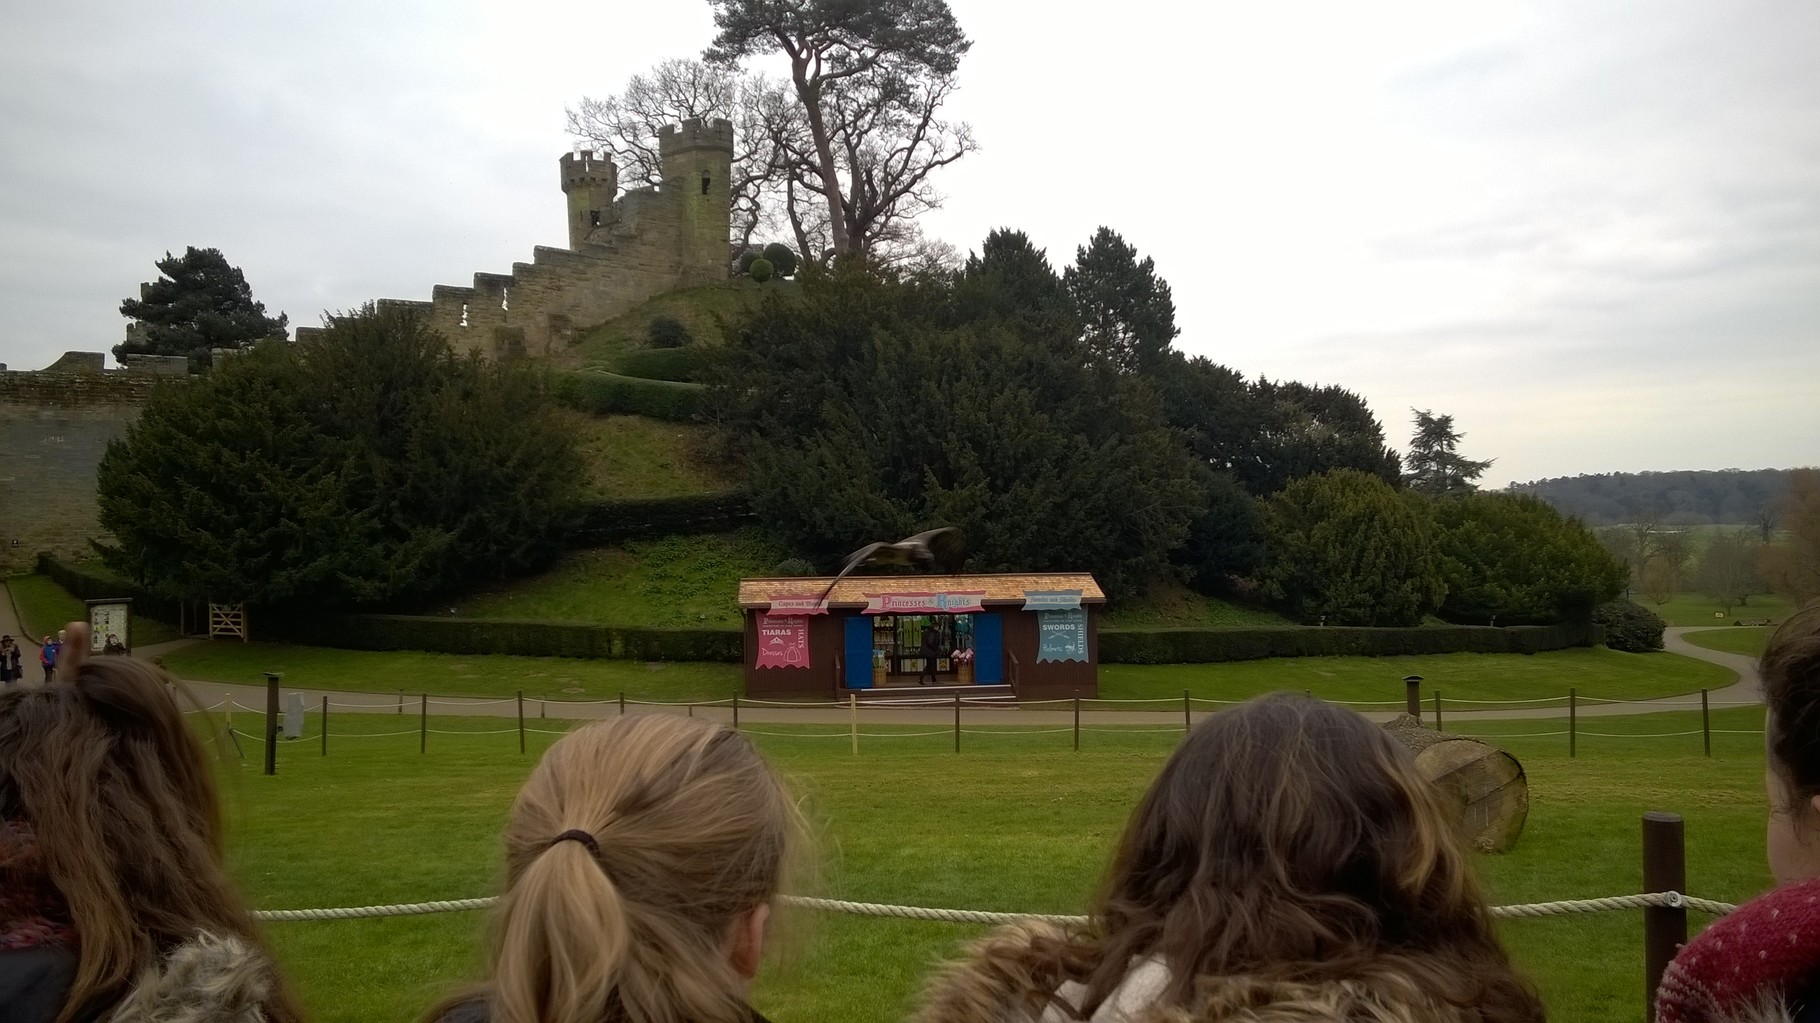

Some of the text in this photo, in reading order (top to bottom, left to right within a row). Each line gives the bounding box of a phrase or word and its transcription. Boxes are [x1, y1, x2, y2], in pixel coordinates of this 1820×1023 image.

[881, 595, 926, 609] Princesses
[935, 594, 970, 611] Knights
[761, 648, 783, 656] Dresses
